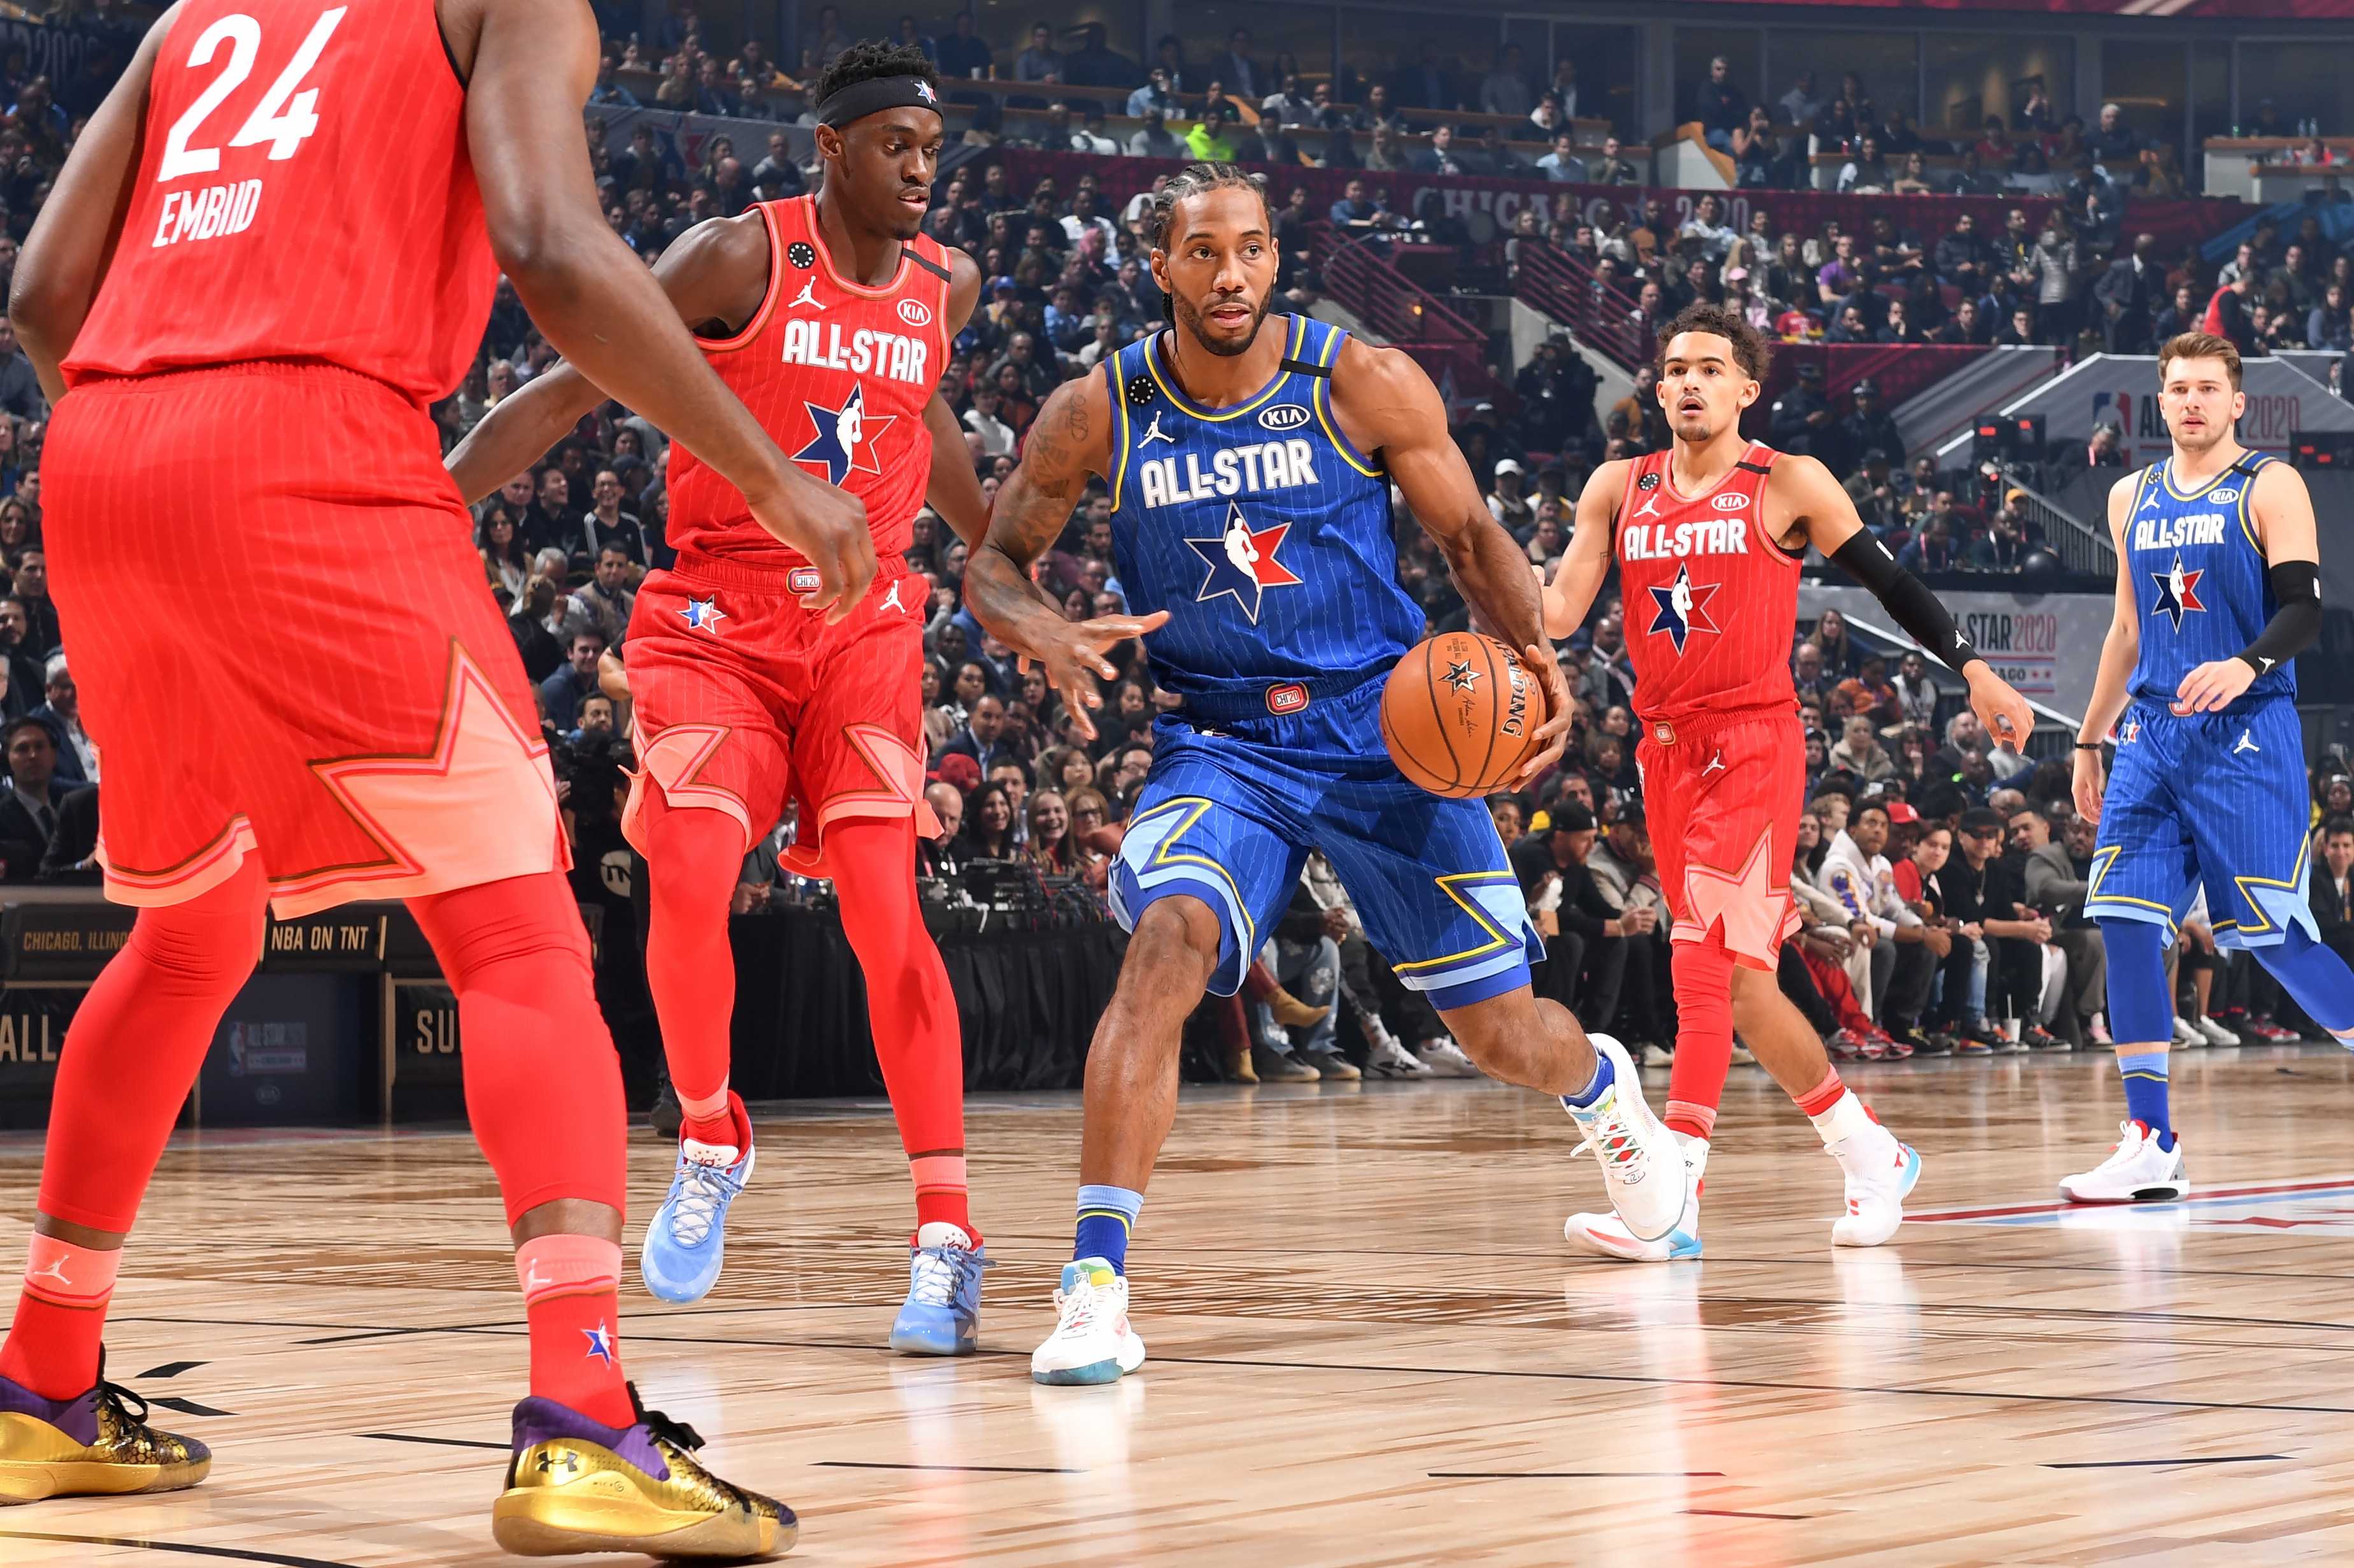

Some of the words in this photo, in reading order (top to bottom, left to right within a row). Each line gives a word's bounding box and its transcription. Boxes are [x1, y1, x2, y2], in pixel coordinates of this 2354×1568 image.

[157, 6, 348, 182] 24
[152, 178, 262, 248] EMBIID
[781, 318, 927, 385] ALL-STAR
[1140, 439, 1318, 509] ALL-STAR
[1624, 518, 1748, 562] ALL-STAR
[2135, 513, 2225, 552] ALL-STAR
[24, 931, 83, 951] CHICAGO,
[271, 925, 304, 951] NBA
[310, 925, 334, 951] ON
[339, 925, 369, 951] TNT
